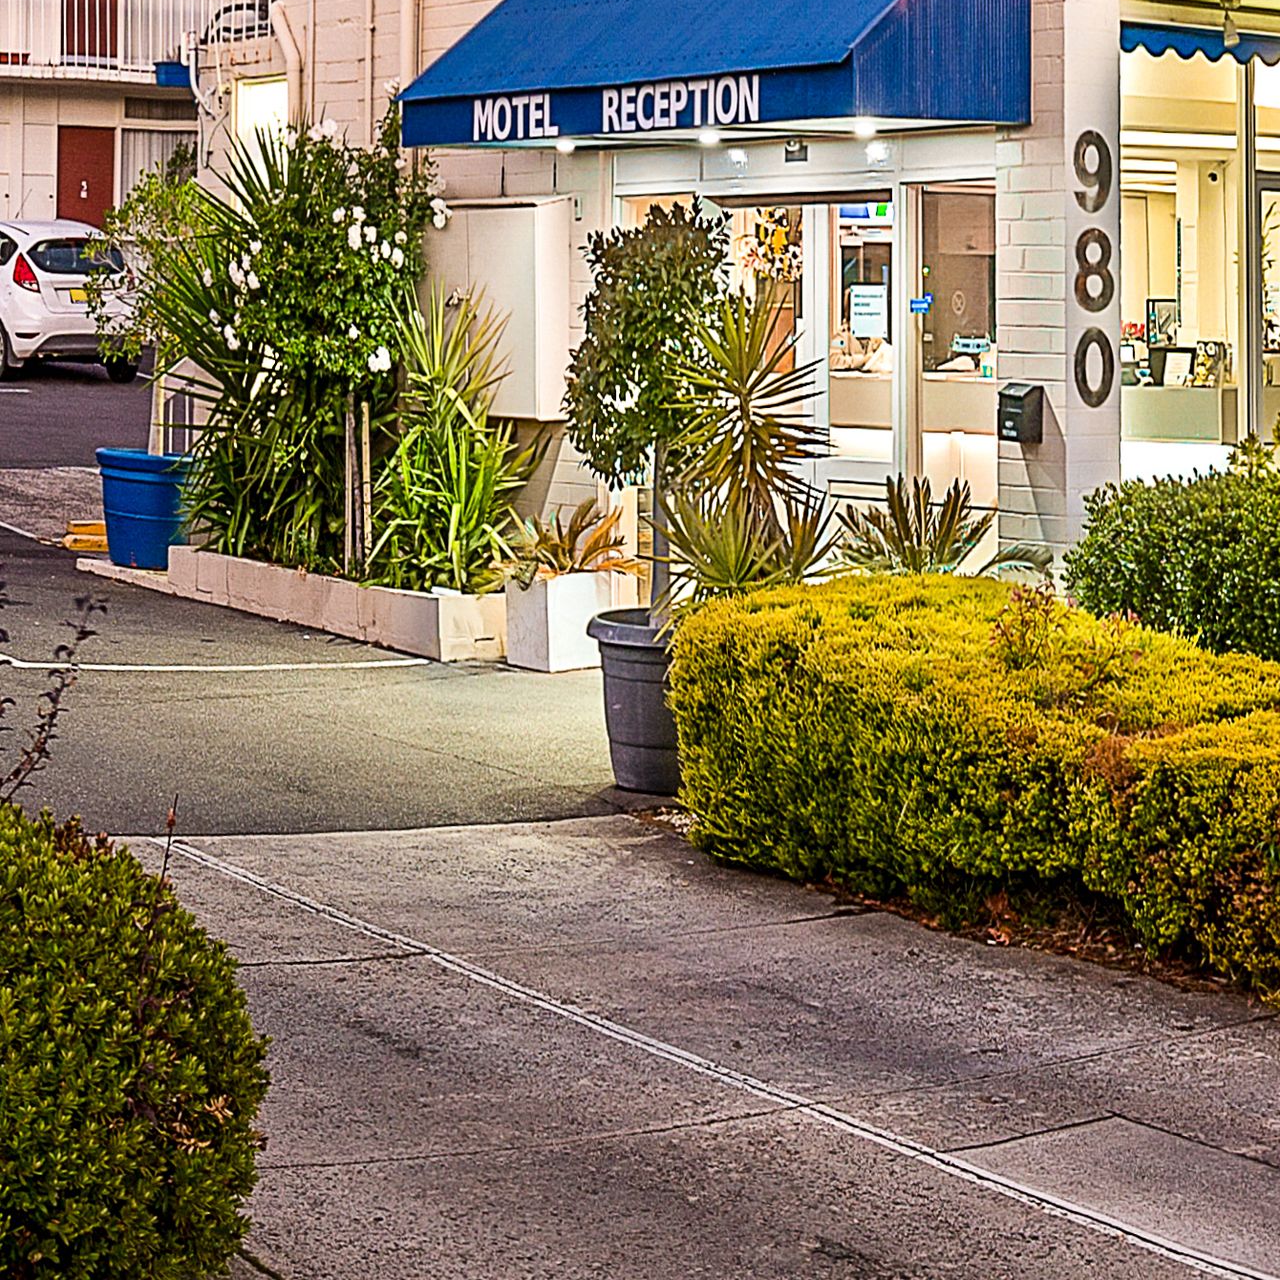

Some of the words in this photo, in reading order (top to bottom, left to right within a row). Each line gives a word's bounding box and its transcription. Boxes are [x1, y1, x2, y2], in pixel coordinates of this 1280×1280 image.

[473, 93, 559, 141] MOTEL
[602, 74, 760, 132] RECEPTION
[1073, 129, 1115, 409] 980
